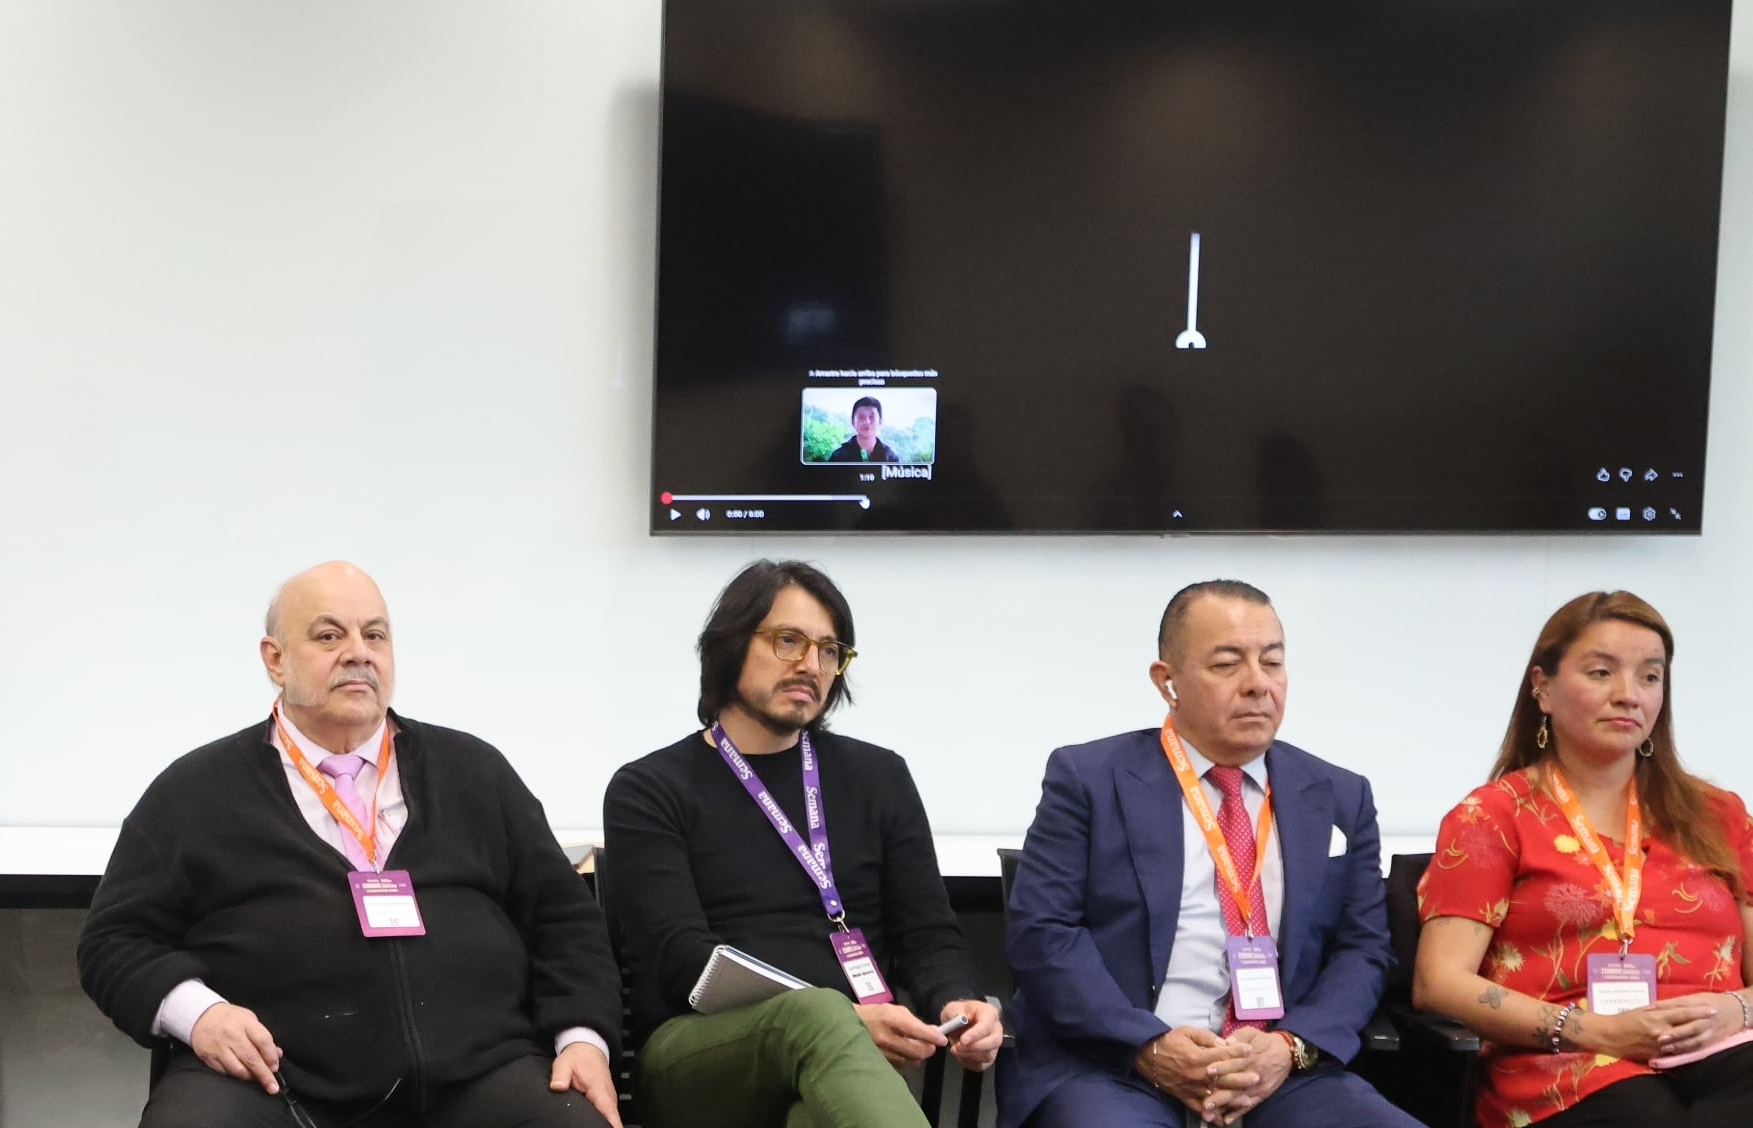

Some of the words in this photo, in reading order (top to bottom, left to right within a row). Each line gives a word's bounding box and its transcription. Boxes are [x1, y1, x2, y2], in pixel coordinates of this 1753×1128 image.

[882, 465, 932, 480] [Música]
[299, 757, 329, 795] Semana
[720, 738, 754, 780] Semana
[758, 790, 793, 834] Semana
[806, 786, 821, 829] Semana
[798, 844, 832, 889] Semana
